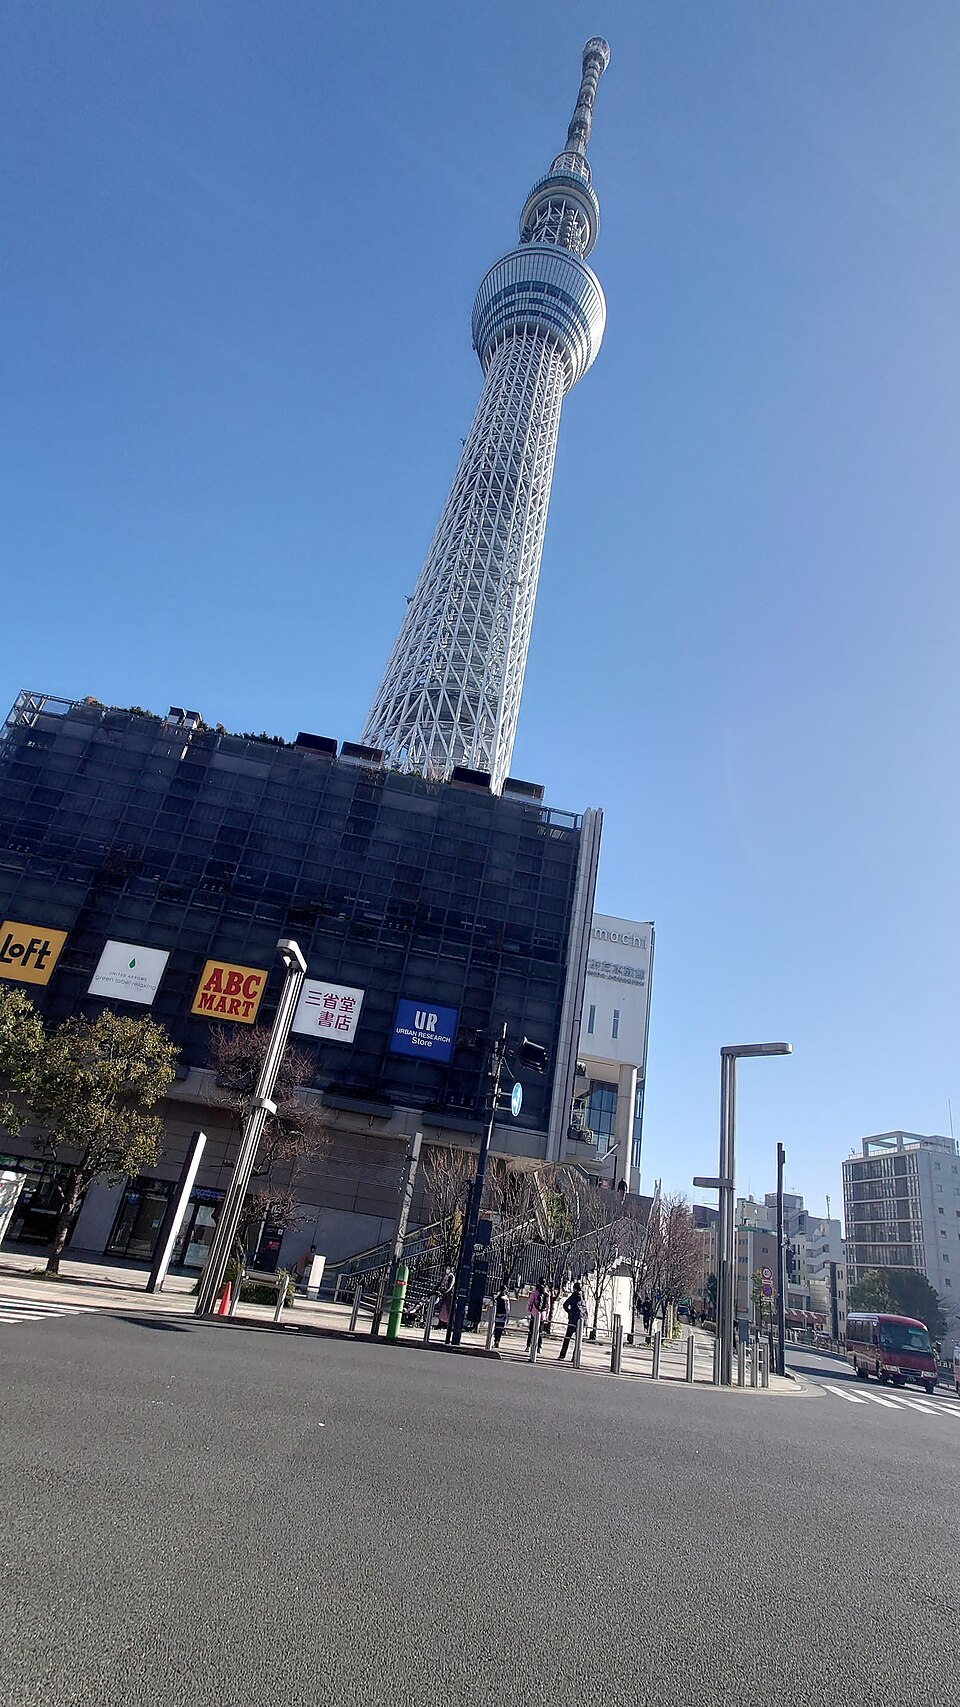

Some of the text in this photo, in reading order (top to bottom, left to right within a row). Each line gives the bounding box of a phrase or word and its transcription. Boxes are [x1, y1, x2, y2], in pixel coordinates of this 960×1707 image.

[593, 928, 647, 950] machi
[95, 974, 114, 982] green
[132, 982, 156, 991] relaxing
[203, 967, 262, 999] ABC
[197, 992, 255, 1018] MART
[304, 990, 357, 1014] 三省堂
[317, 1010, 353, 1032] 書店
[414, 1010, 438, 1032] UR
[395, 1027, 451, 1043] URBAN RESEARCH
[411, 1036, 433, 1047] Store
